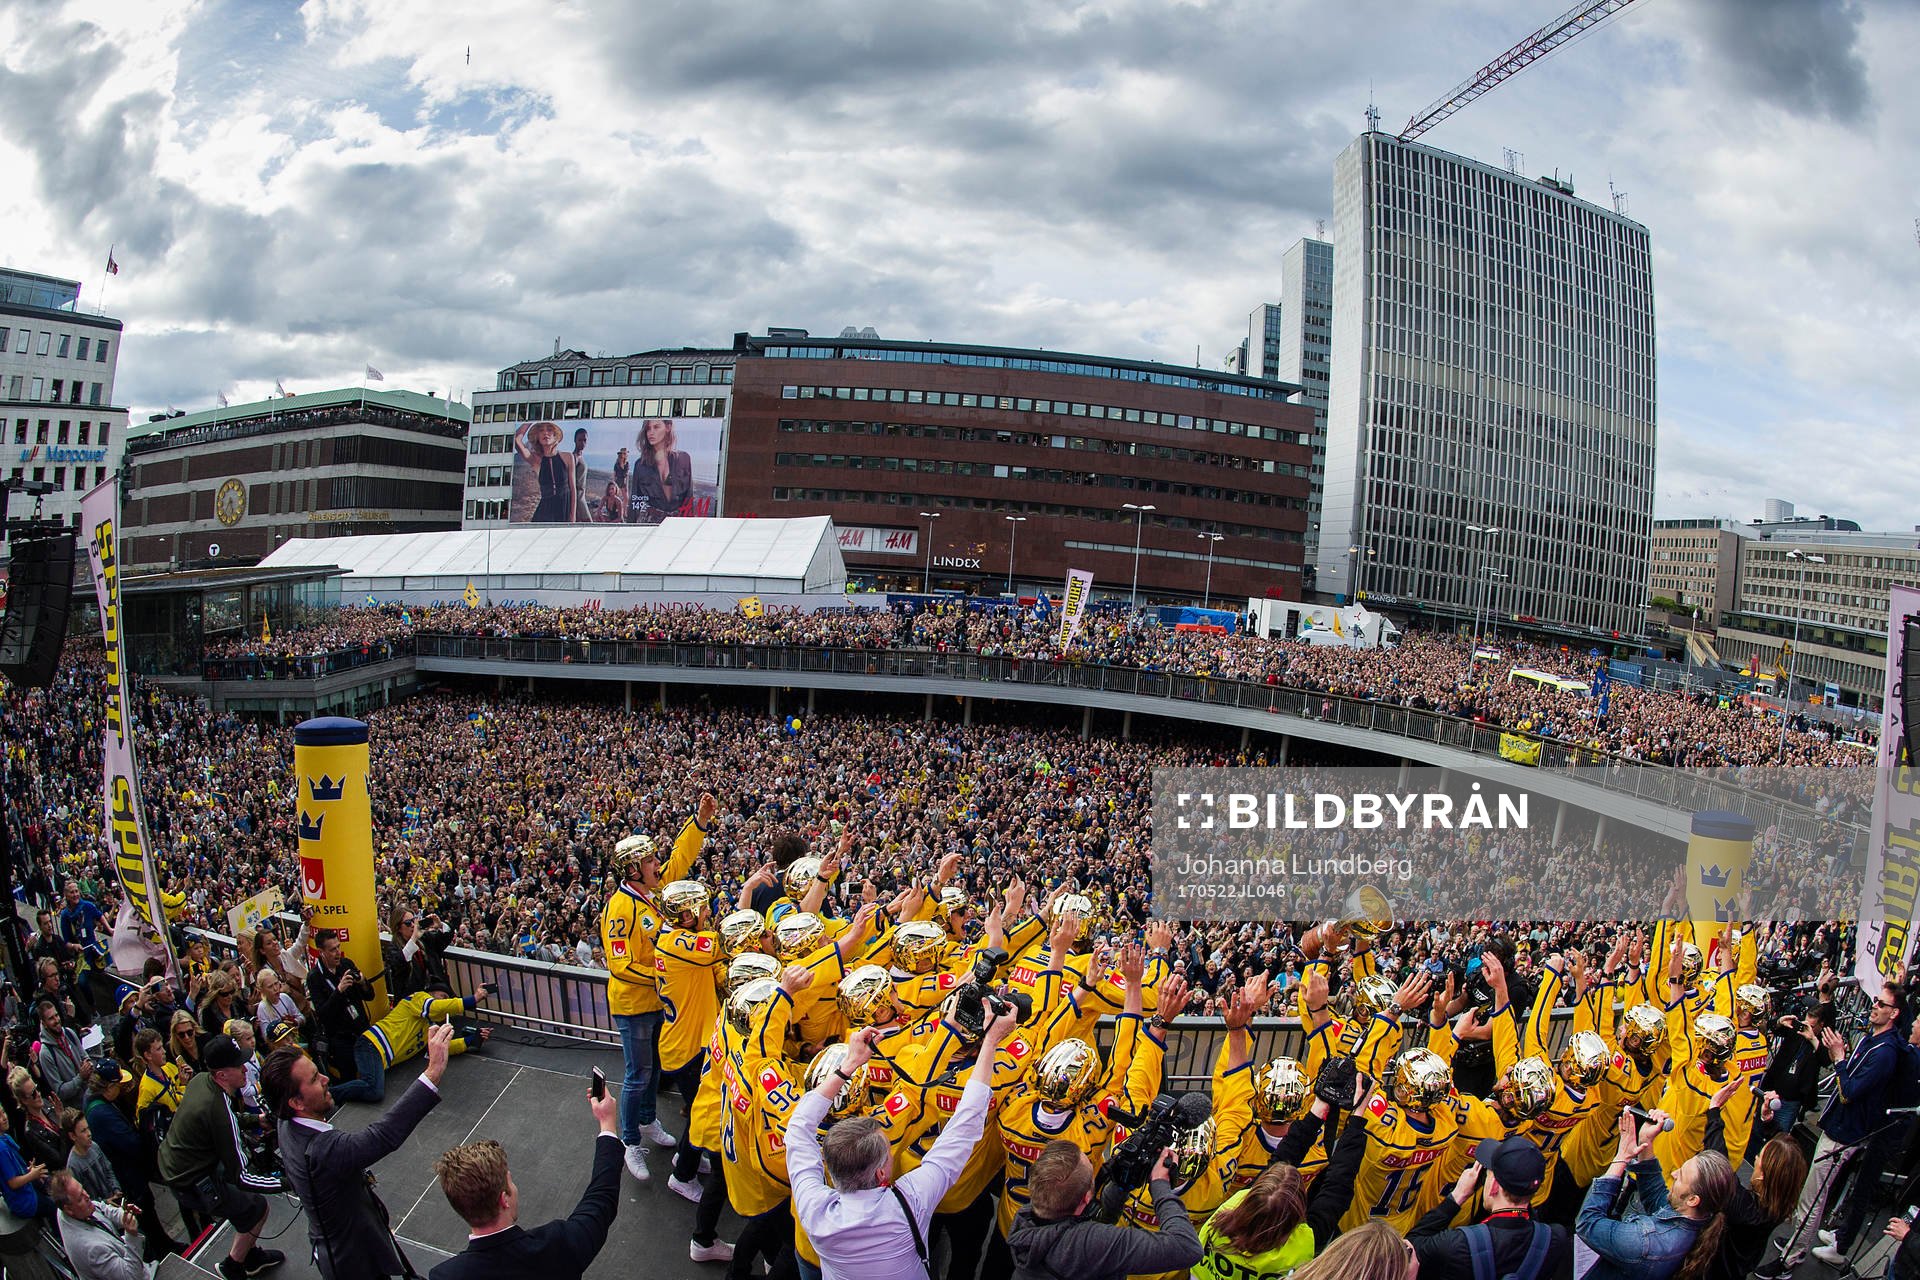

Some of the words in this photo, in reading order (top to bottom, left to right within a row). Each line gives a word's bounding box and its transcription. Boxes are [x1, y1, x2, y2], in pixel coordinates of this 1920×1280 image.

[46, 445, 107, 464] Manpower
[933, 556, 980, 569] LINDEX
[1065, 575, 1084, 617] SPORT
[1367, 594, 1397, 604] MANGO
[323, 905, 349, 915] SPEL
[608, 918, 627, 938] 22
